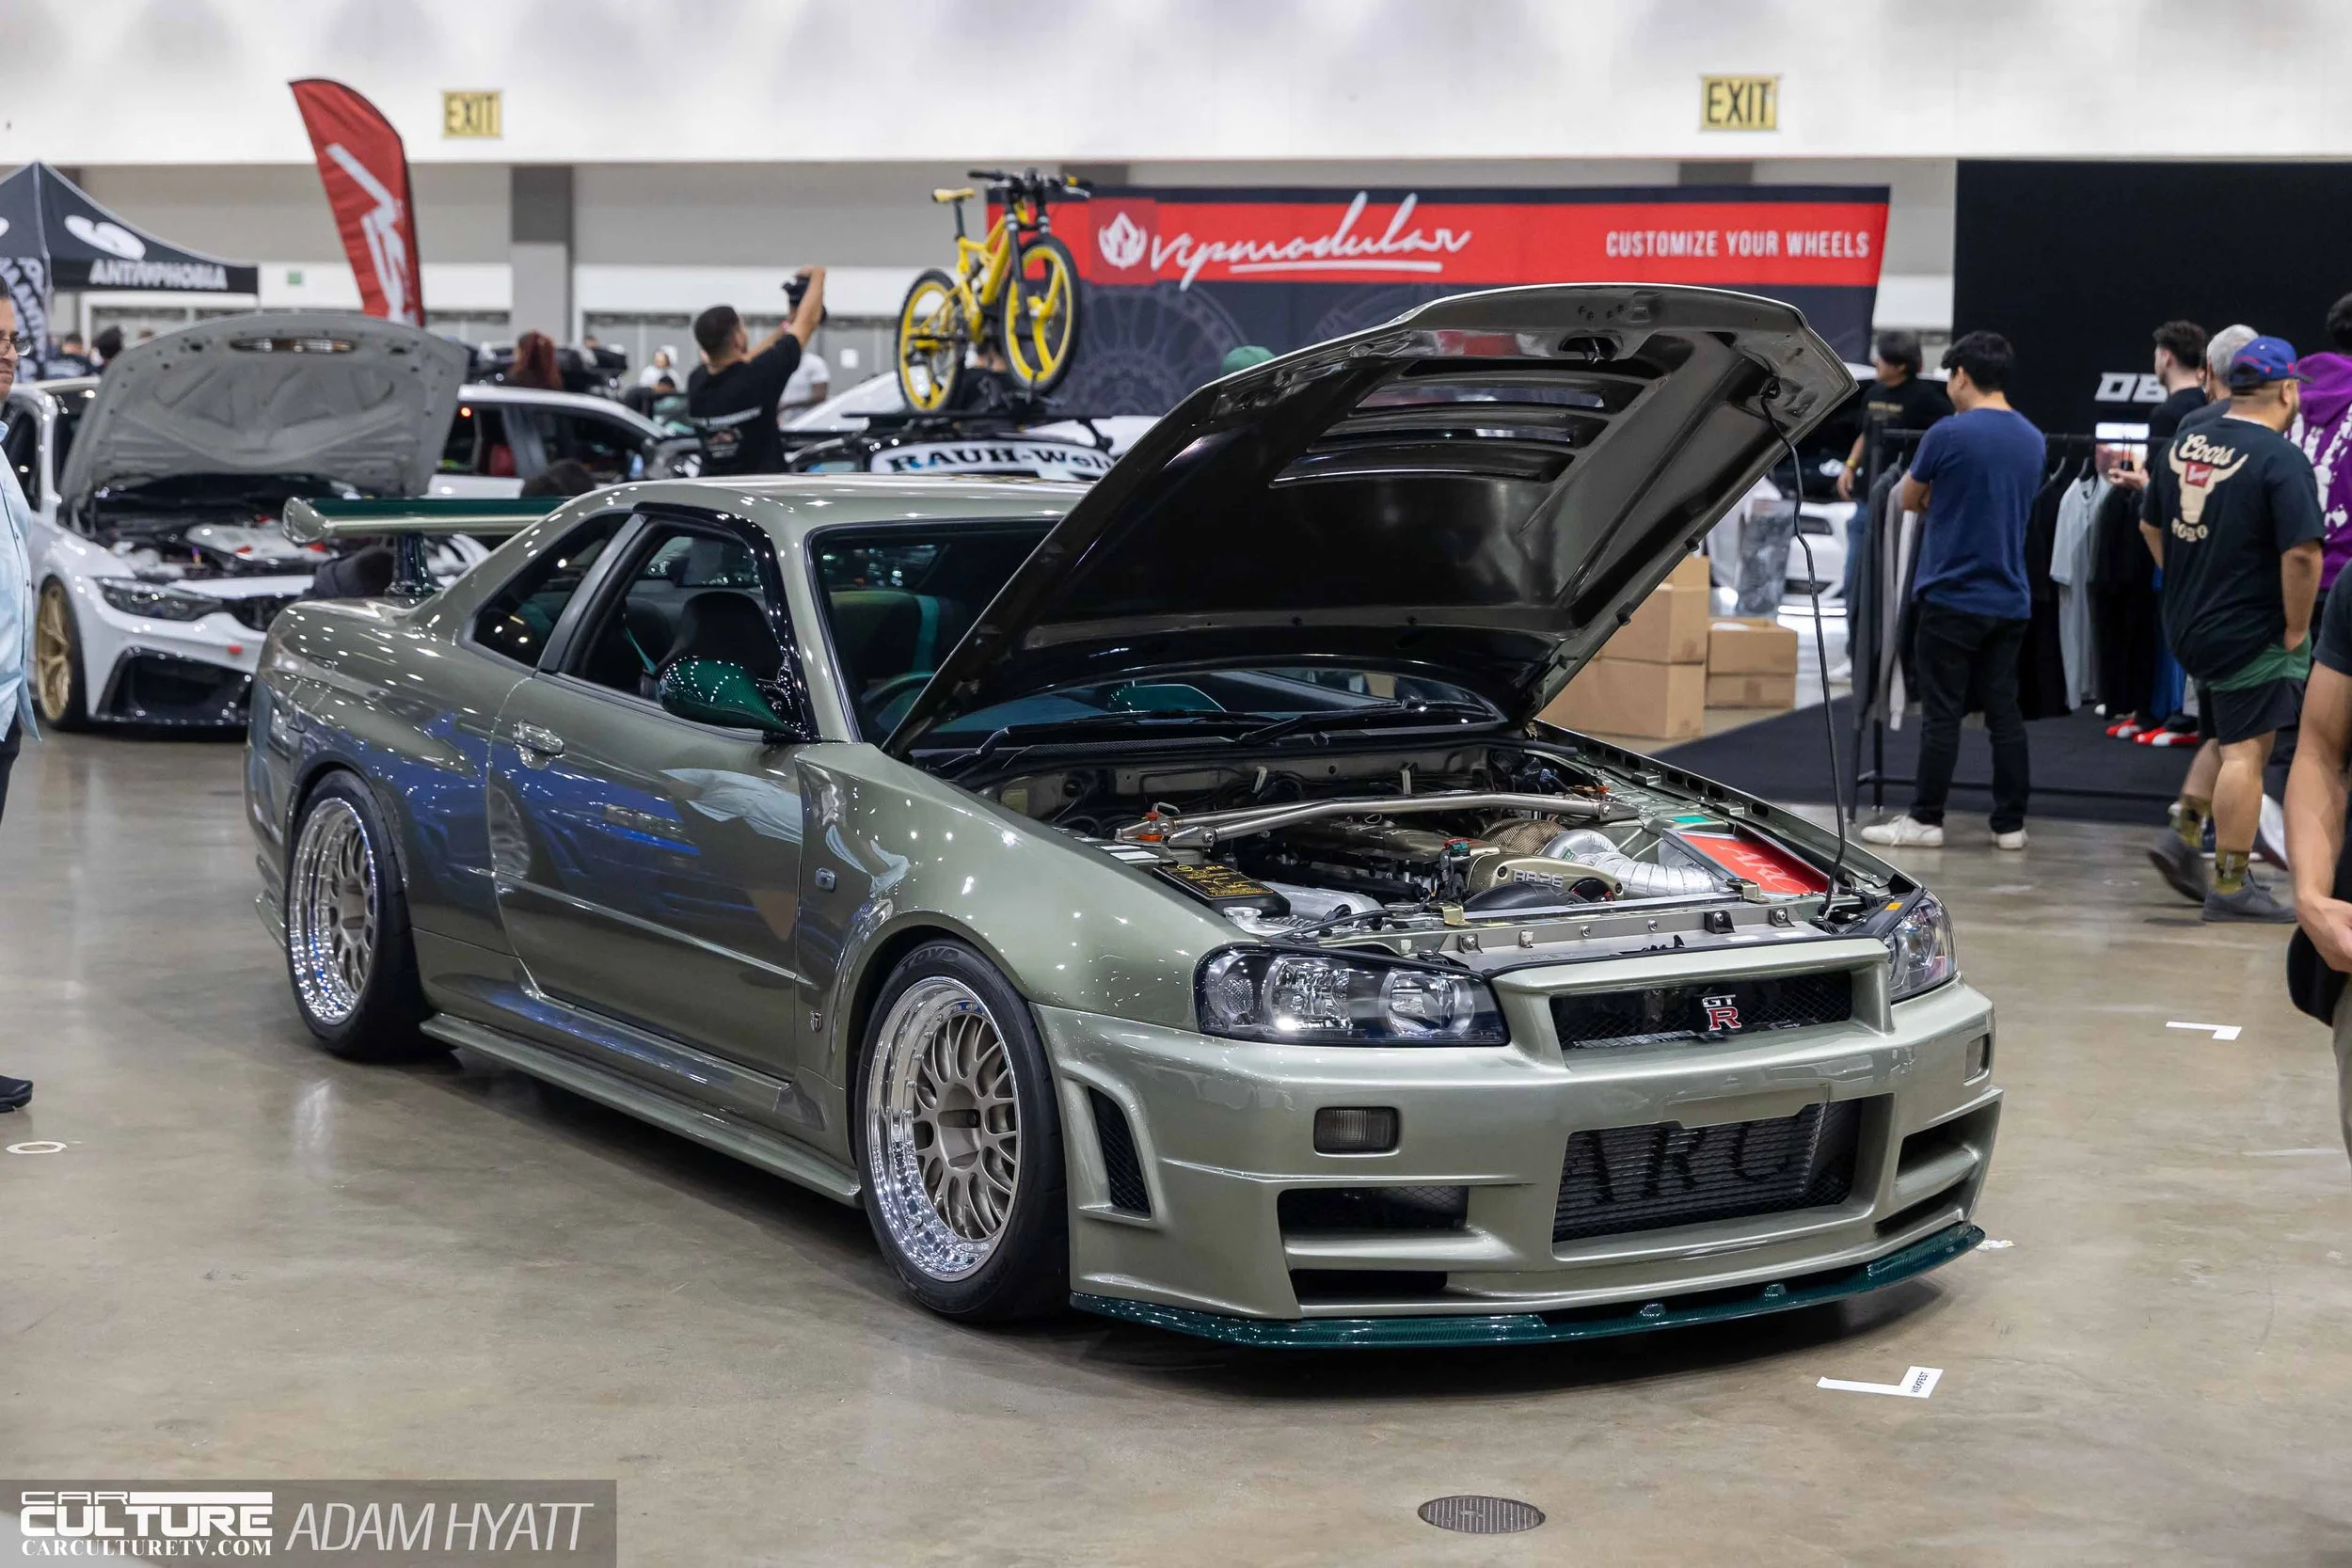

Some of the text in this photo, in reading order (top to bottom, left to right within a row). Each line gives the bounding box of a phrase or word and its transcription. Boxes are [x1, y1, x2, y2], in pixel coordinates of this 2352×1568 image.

[446, 93, 497, 135] EXIT
[1708, 81, 1772, 123] EXIT
[1605, 230, 1870, 258] CUSTOMIZE YOUR WHEELS
[2179, 434, 2236, 467] Coors
[1513, 869, 1564, 887] RB26
[1702, 994, 1736, 1007] GT
[1707, 1006, 1741, 1031] R
